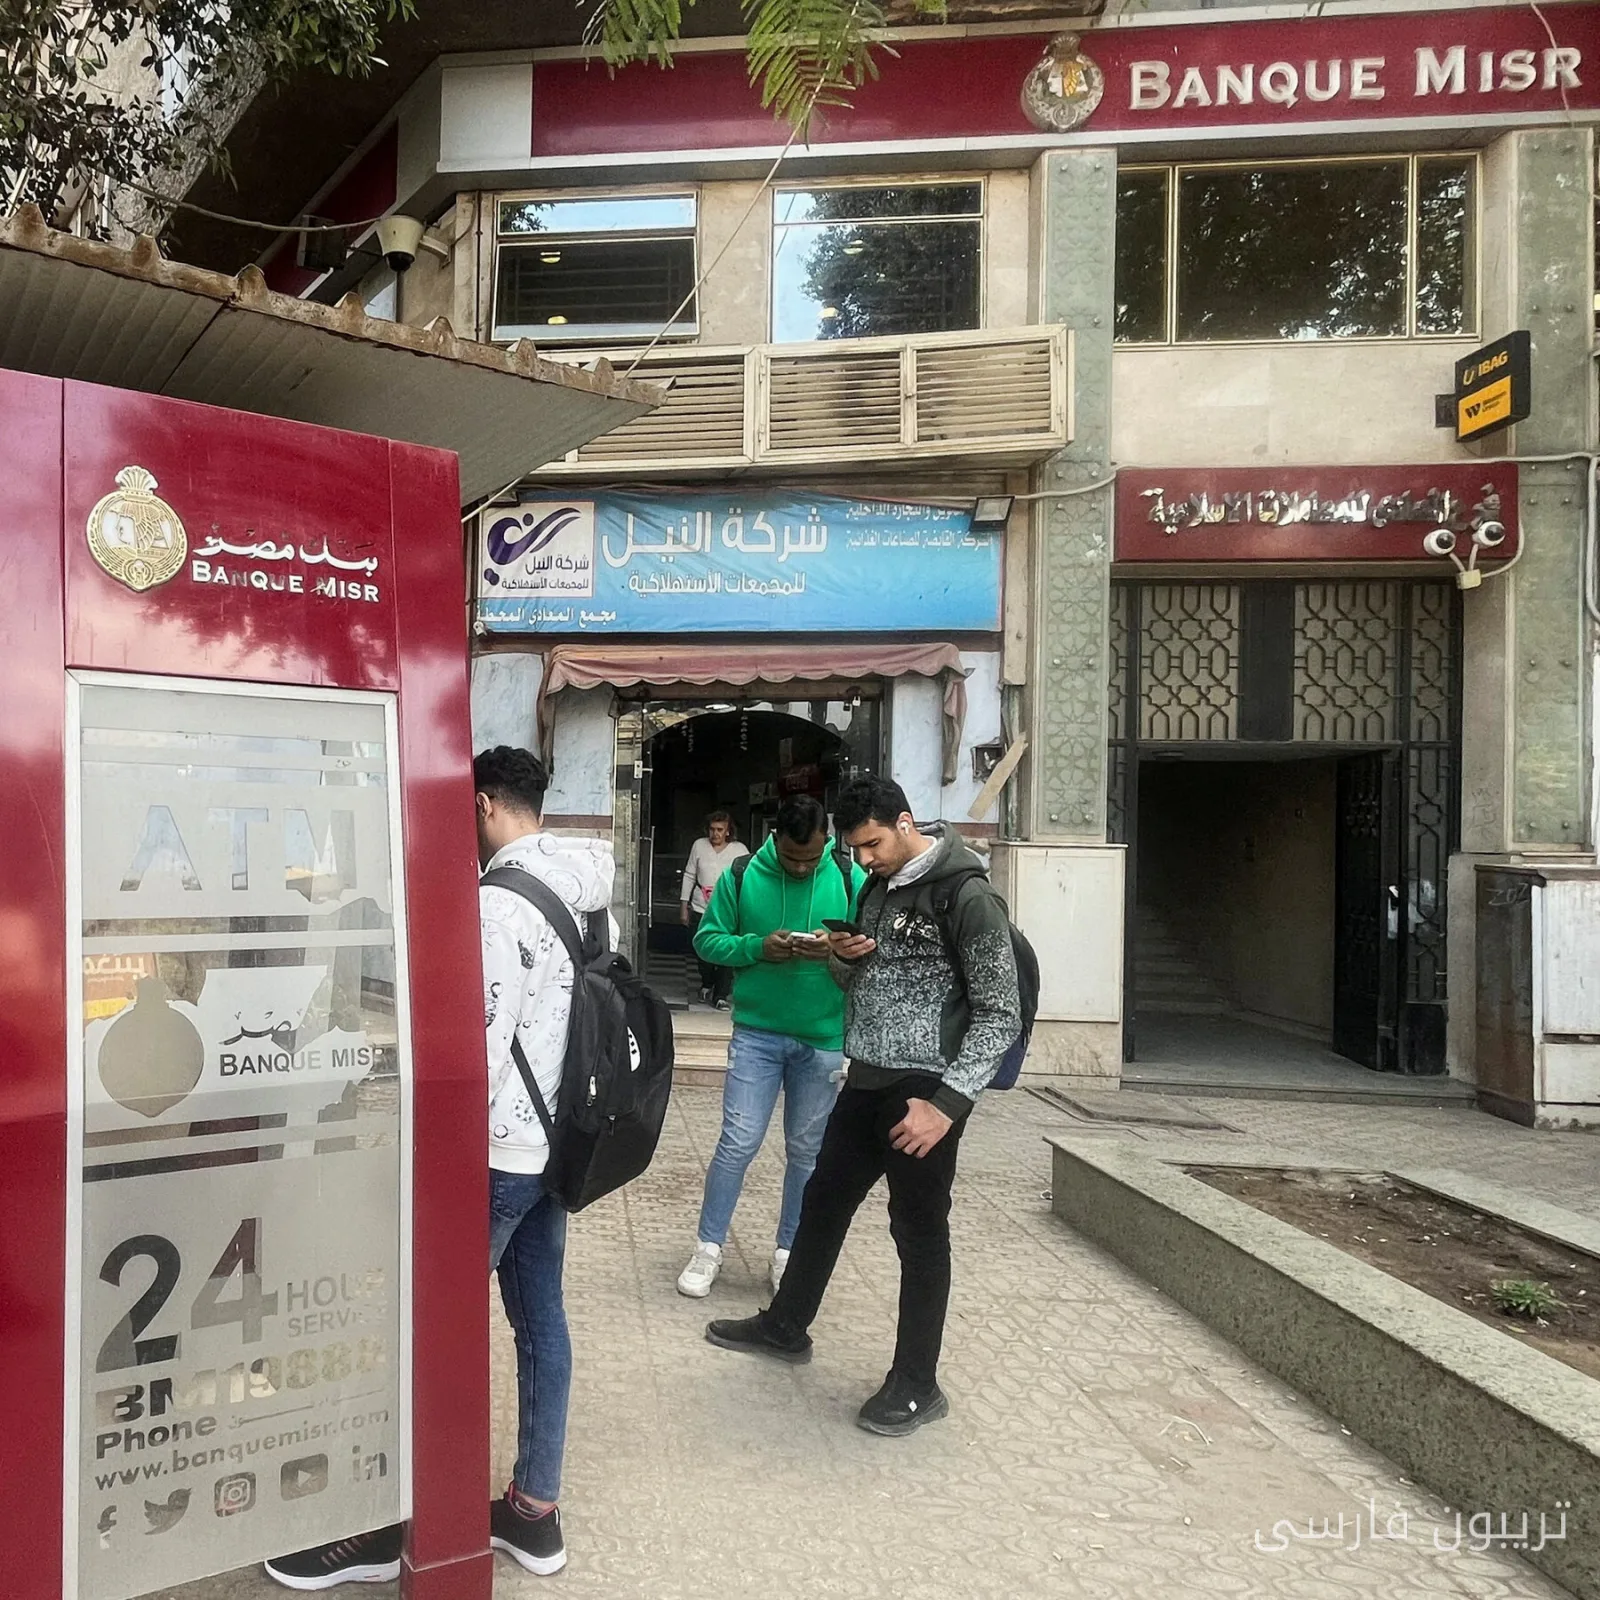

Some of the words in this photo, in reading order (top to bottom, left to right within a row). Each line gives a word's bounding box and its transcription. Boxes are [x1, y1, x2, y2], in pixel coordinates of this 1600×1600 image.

[1129, 57, 1387, 111] BANQUE
[1413, 45, 1583, 97] MISR
[601, 511, 712, 568] النيل
[721, 506, 828, 563] شركة
[191, 559, 305, 594] BANQUE
[311, 576, 380, 603] MISR
[525, 555, 553, 575] النيل
[549, 578, 589, 591] للمجمعات
[555, 555, 590, 574] شركة
[724, 572, 806, 598] للمجمعات
[578, 608, 617, 628] مجمع
[119, 804, 358, 893] ATM
[220, 1050, 322, 1077] BANQUE
[95, 1216, 279, 1374] 24
[95, 1414, 216, 1460] Phone
[95, 1408, 390, 1491] www.banquemisr.com
